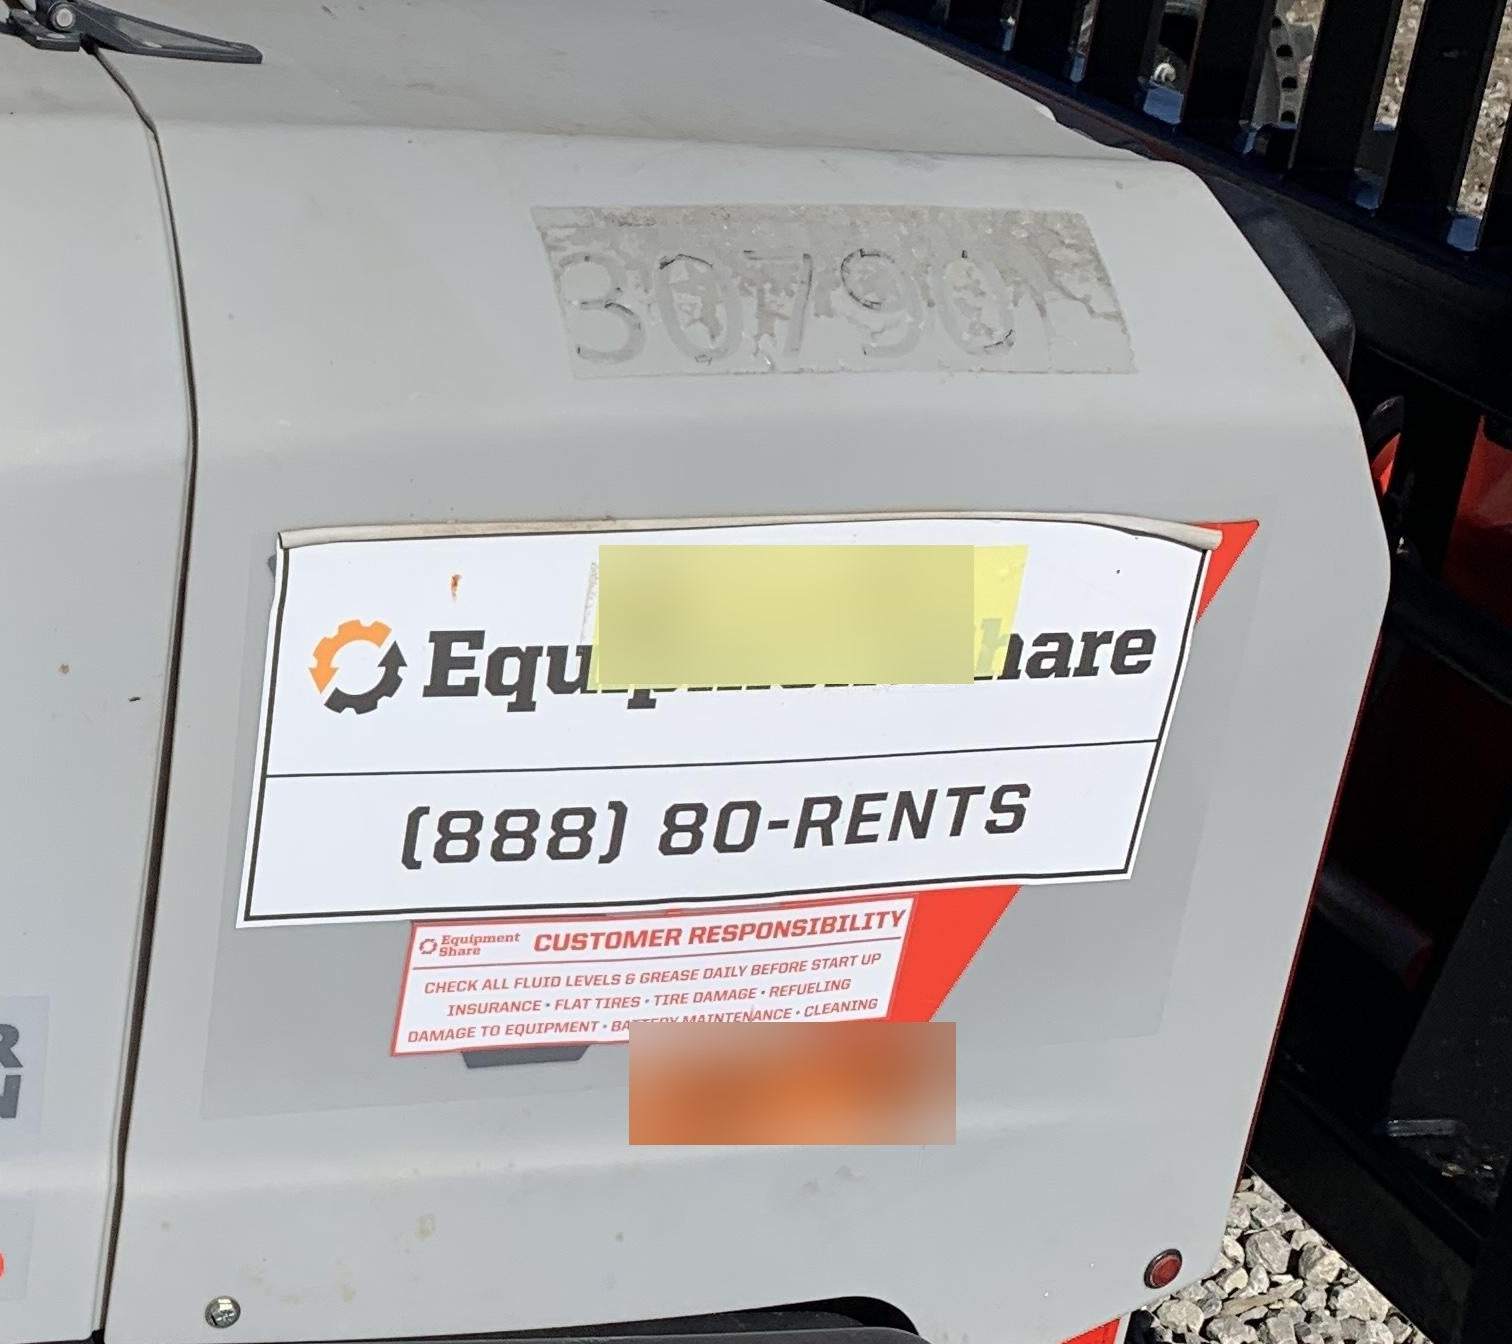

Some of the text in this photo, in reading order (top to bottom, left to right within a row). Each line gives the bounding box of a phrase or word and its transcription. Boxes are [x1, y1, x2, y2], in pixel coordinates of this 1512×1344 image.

[401, 783, 1032, 871] (888) 80-RENTS
[439, 945, 481, 957] Share
[440, 932, 521, 947] Equipment
[533, 909, 907, 952] CUSTOMER RESPONSIBILITY
[424, 952, 882, 994] CHECK ALL FLUID LEVELS & GREASE DAILY BEFORE START UP
[446, 978, 852, 1017] INSURANCE FLAT TIRES TIRE DAMAGE REFUELING
[407, 1026, 476, 1043] DAMAGE
[481, 1025, 500, 1038] TO
[504, 1020, 600, 1037] EQUIPMENT
[804, 998, 878, 1017] CLEANING
